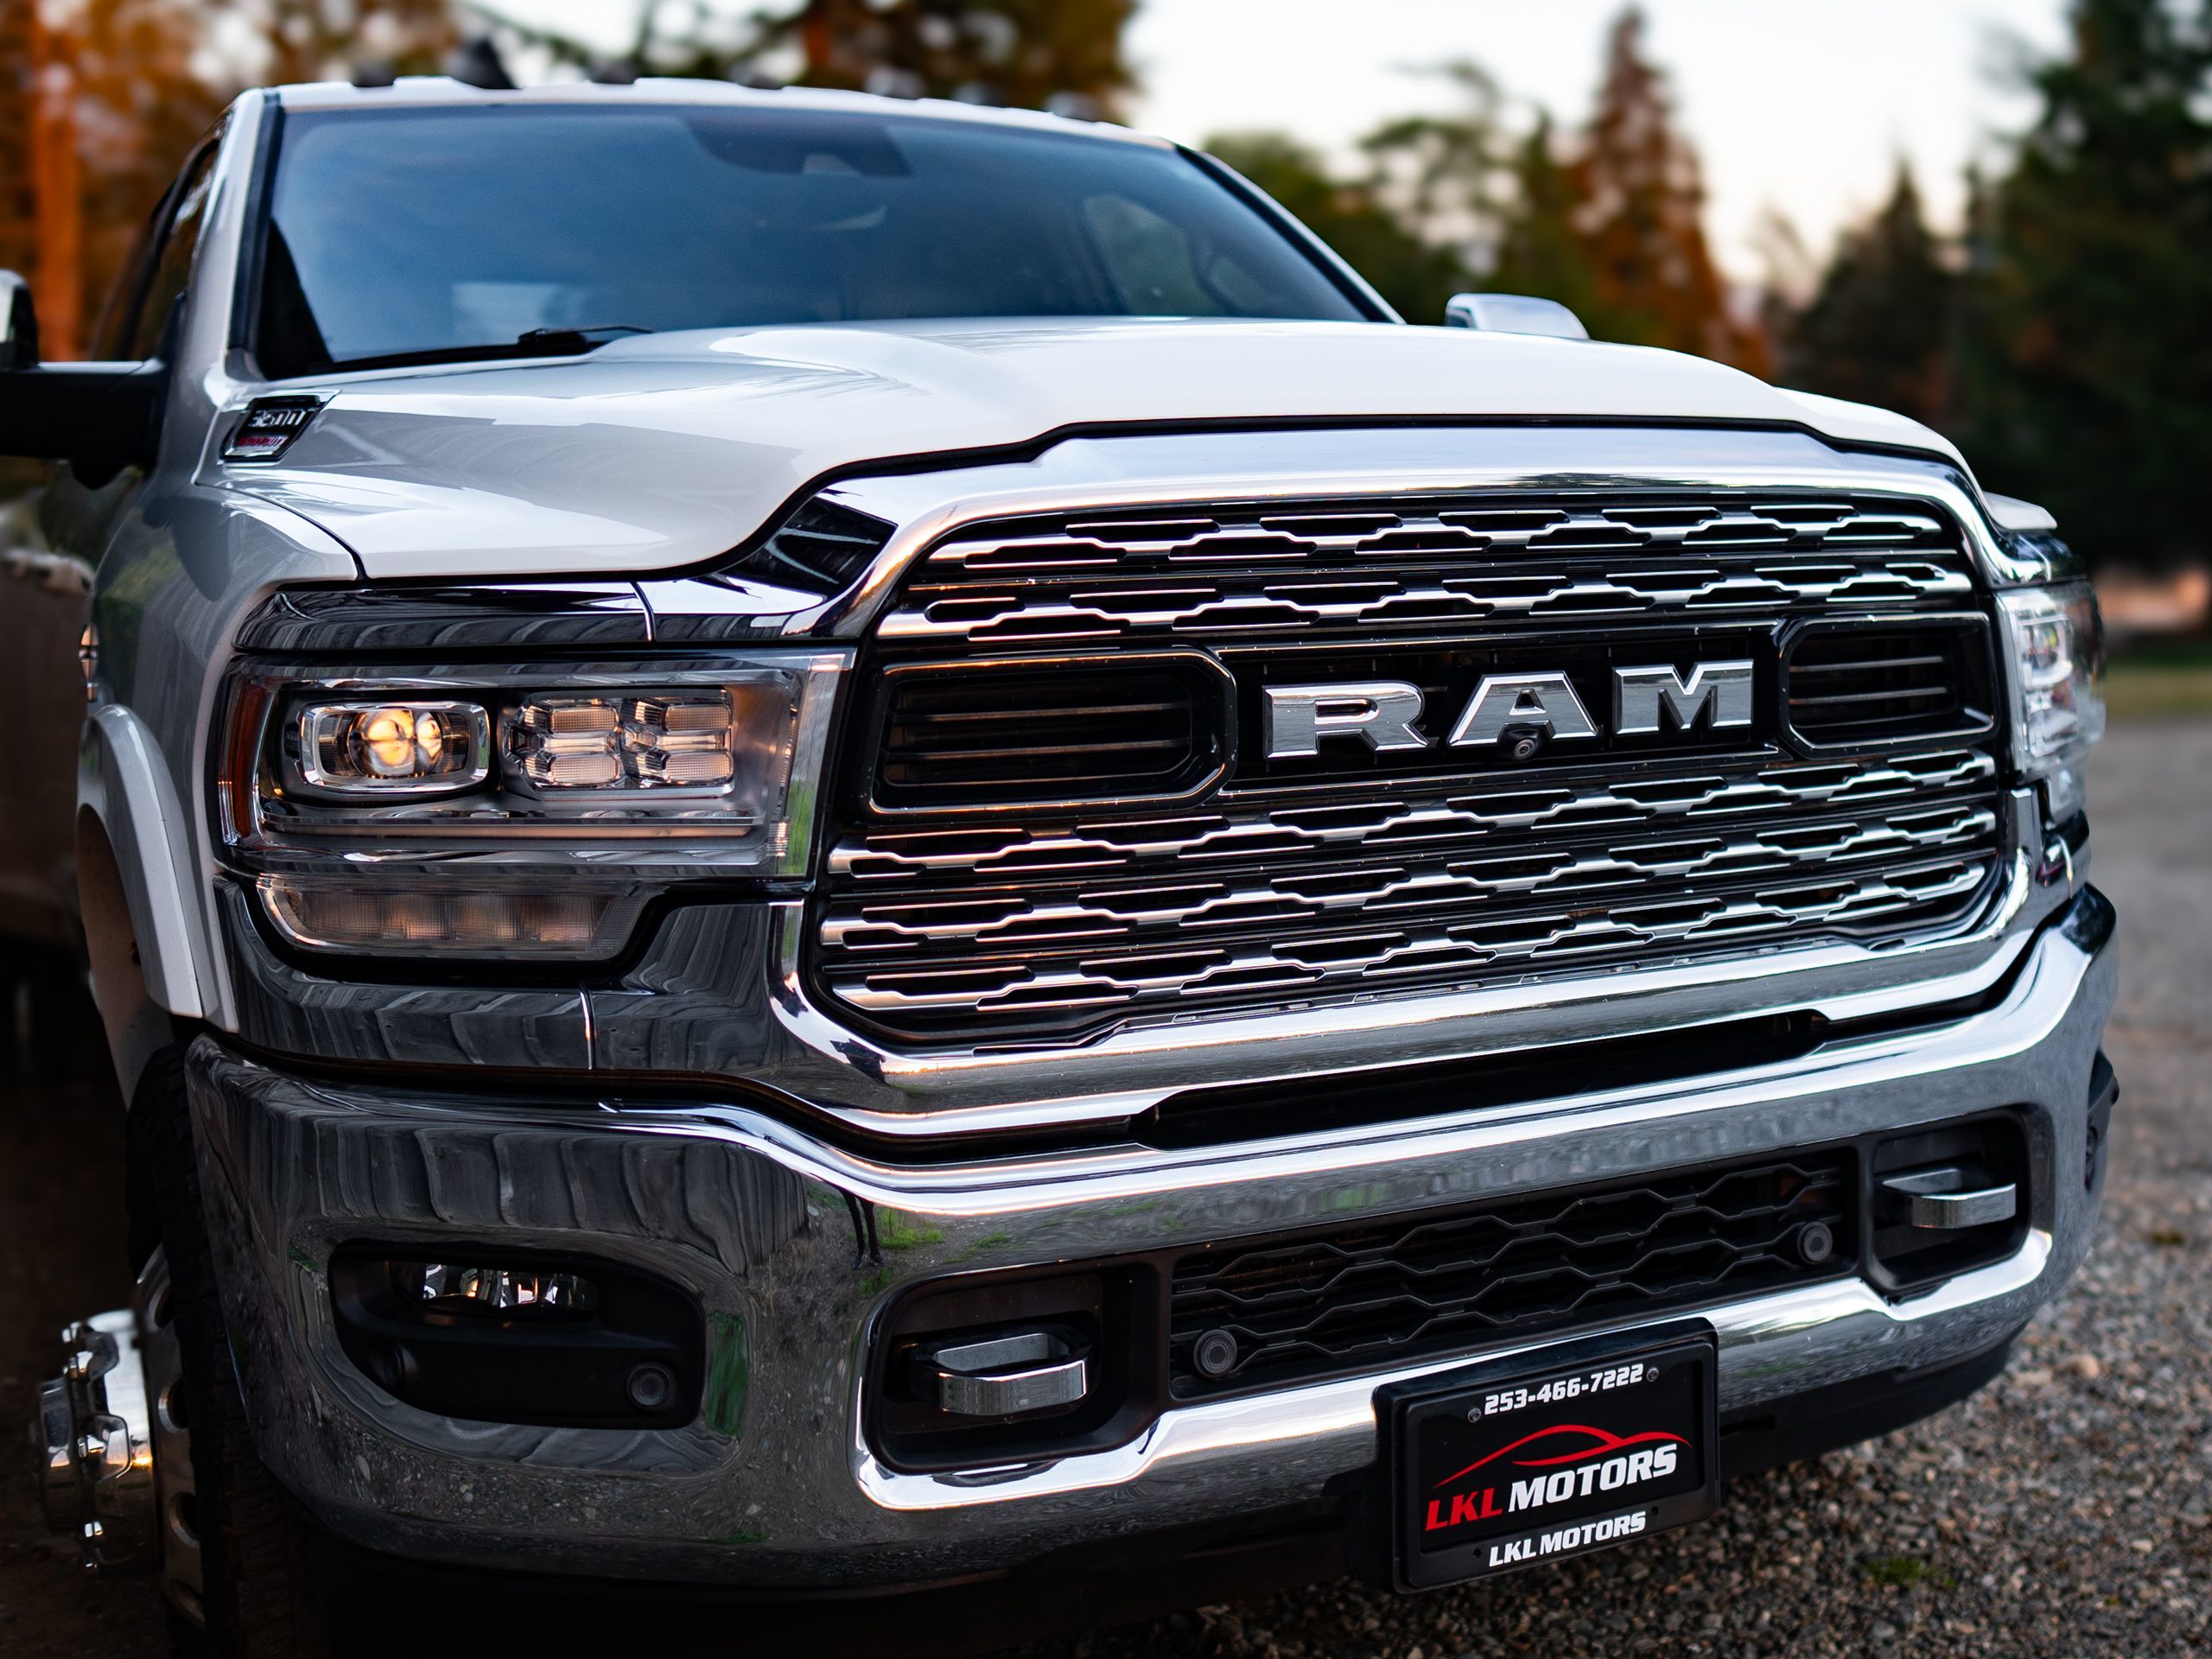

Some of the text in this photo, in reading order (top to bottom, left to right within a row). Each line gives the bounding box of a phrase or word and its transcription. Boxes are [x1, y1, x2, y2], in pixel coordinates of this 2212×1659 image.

[1262, 659, 1754, 759] RAM
[1484, 1363, 1643, 1415] 253-466-7222
[1424, 1444, 1677, 1531] LKL MOTORS
[1489, 1510, 1646, 1567] LKL MOTORS
